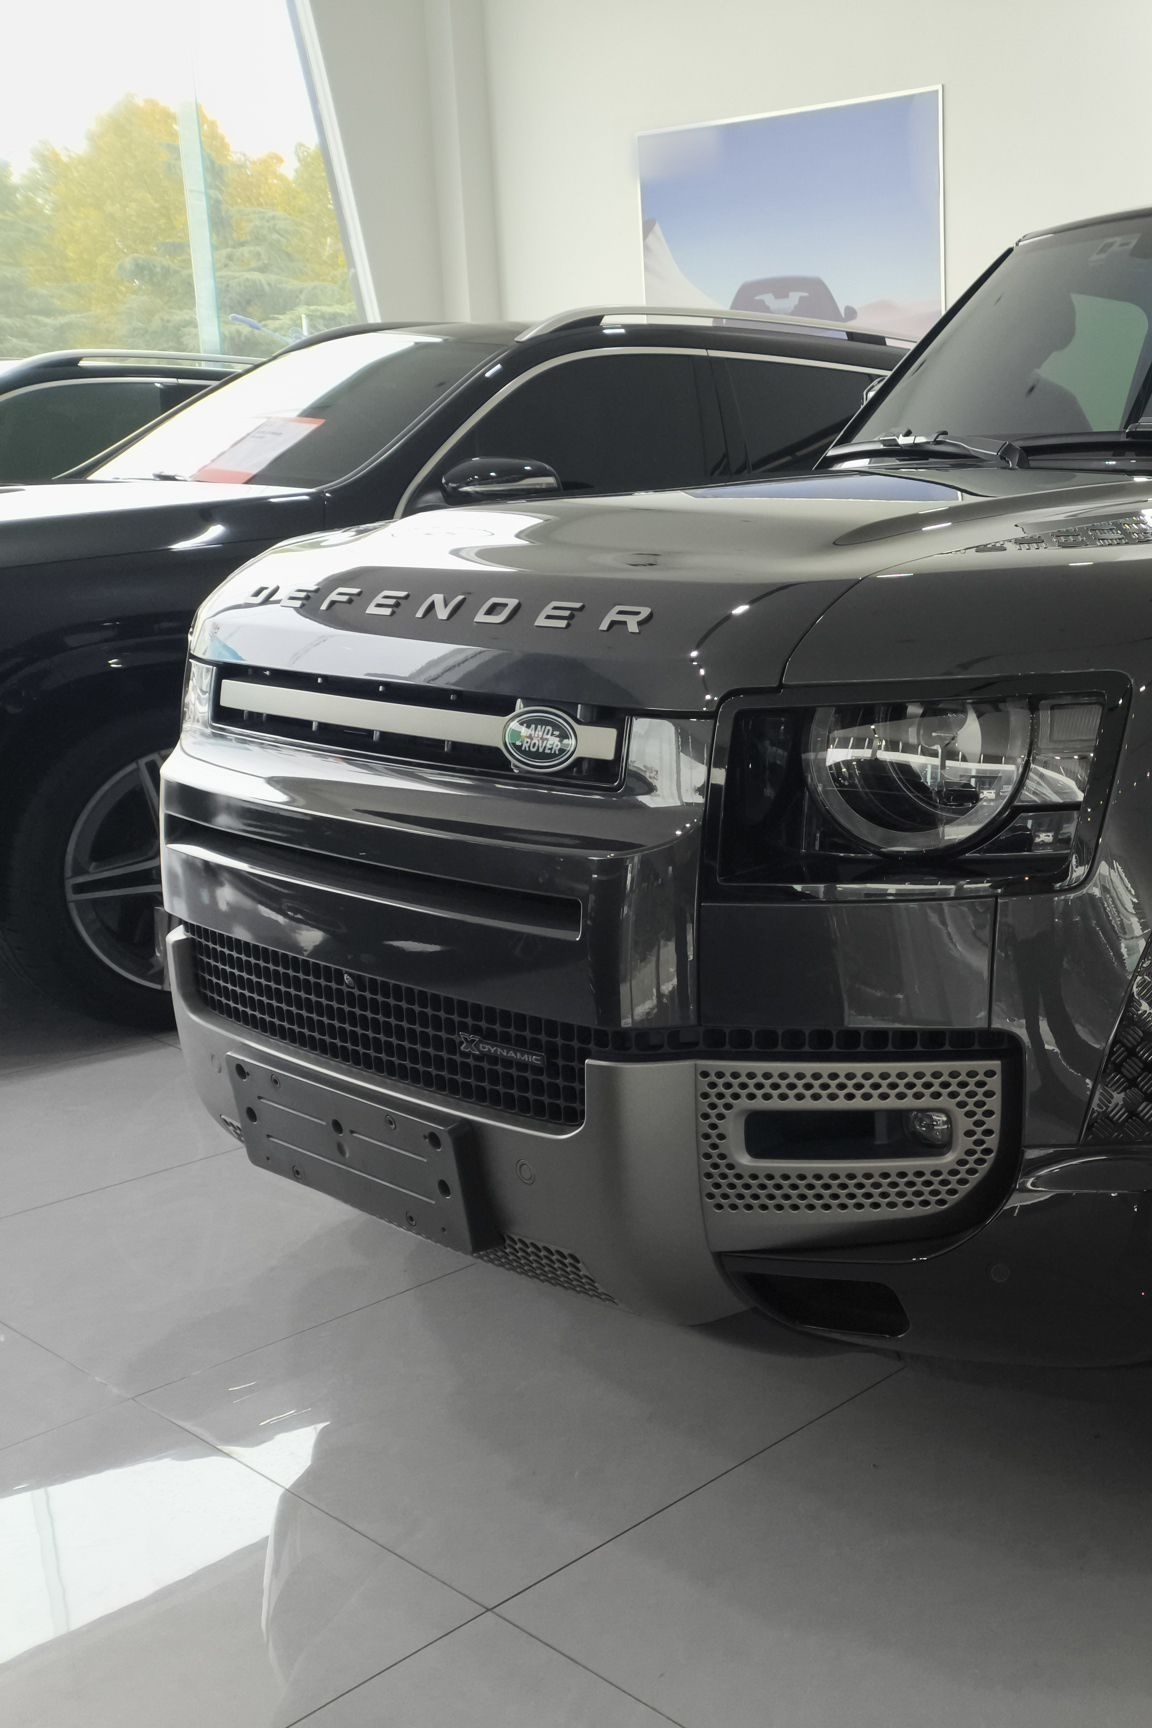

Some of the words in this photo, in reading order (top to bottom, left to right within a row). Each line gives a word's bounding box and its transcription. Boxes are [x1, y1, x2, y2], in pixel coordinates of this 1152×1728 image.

[245, 584, 654, 633] DEFENDER
[520, 723, 553, 738] LAND
[521, 738, 561, 754] ROVER
[480, 1043, 542, 1064] DYNAMIC
